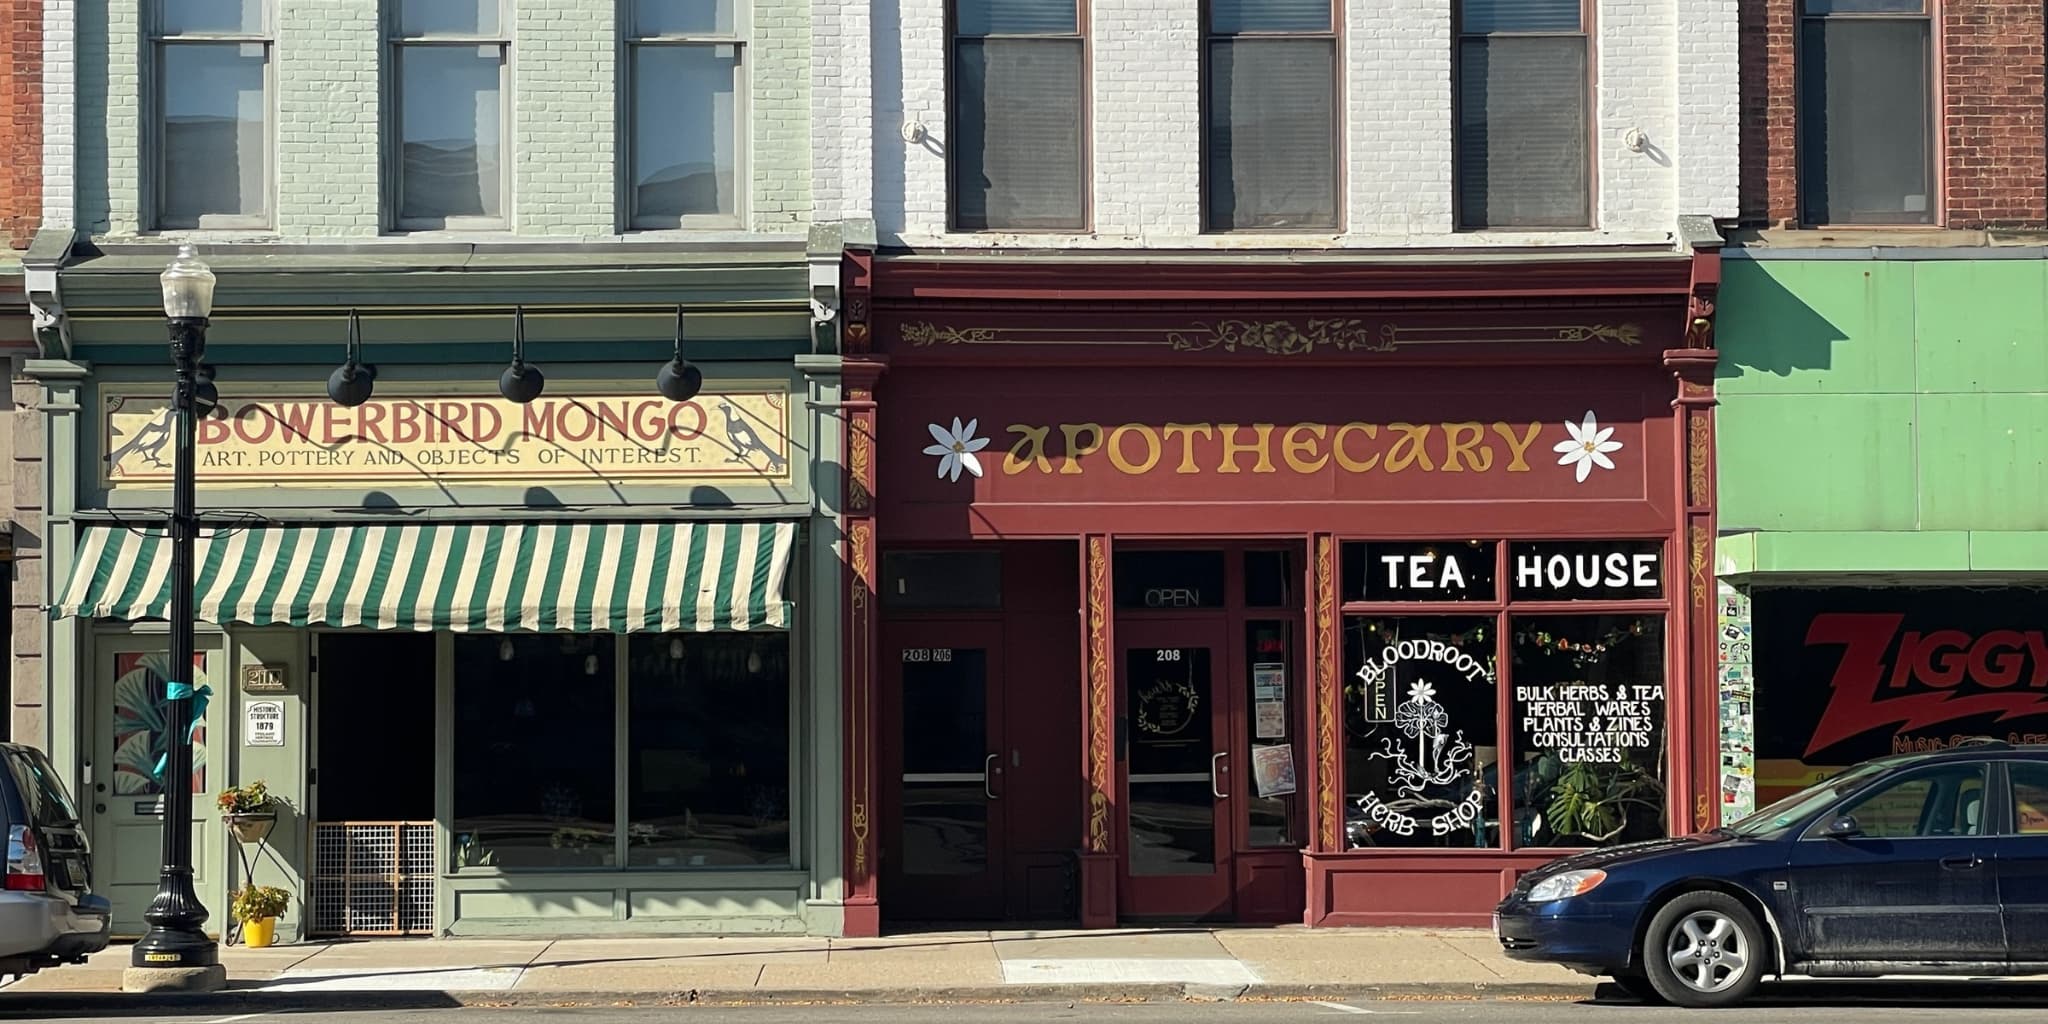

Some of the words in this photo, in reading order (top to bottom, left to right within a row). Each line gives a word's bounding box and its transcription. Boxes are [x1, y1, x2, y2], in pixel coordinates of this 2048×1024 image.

[197, 402, 502, 444] BOWERBIRD
[522, 401, 707, 442] MONGO
[259, 450, 354, 466] POTTERY
[363, 450, 403, 465] AND
[417, 449, 520, 465] OBJECTS
[538, 449, 565, 464] OF
[581, 447, 701, 463] INTEREST.
[1003, 421, 1542, 475] APOTHECARY
[1381, 555, 1466, 588] TEA
[1518, 553, 1658, 588] HOUSE
[1144, 588, 1199, 607] OPEN
[904, 649, 929, 661] 208
[935, 649, 951, 661] 206
[1156, 649, 1181, 662] 208
[1355, 640, 1487, 685] BLOODROOT
[1517, 686, 1554, 701] BULK
[1560, 685, 1609, 701] HERBS
[1616, 684, 1627, 701] &
[1632, 685, 1664, 701] TEA
[1528, 701, 1585, 716] HERBAL
[1595, 701, 1650, 716] WARES
[256, 722, 274, 730] 1879
[1524, 717, 1583, 732] PLANTS
[1589, 716, 1600, 731] &
[1606, 717, 1653, 731] ZINES
[1533, 732, 1649, 747] CONSULTATIONS
[1559, 747, 1621, 763] CLASSES
[1356, 790, 1419, 836] HERB
[1431, 789, 1483, 836] SHOP
